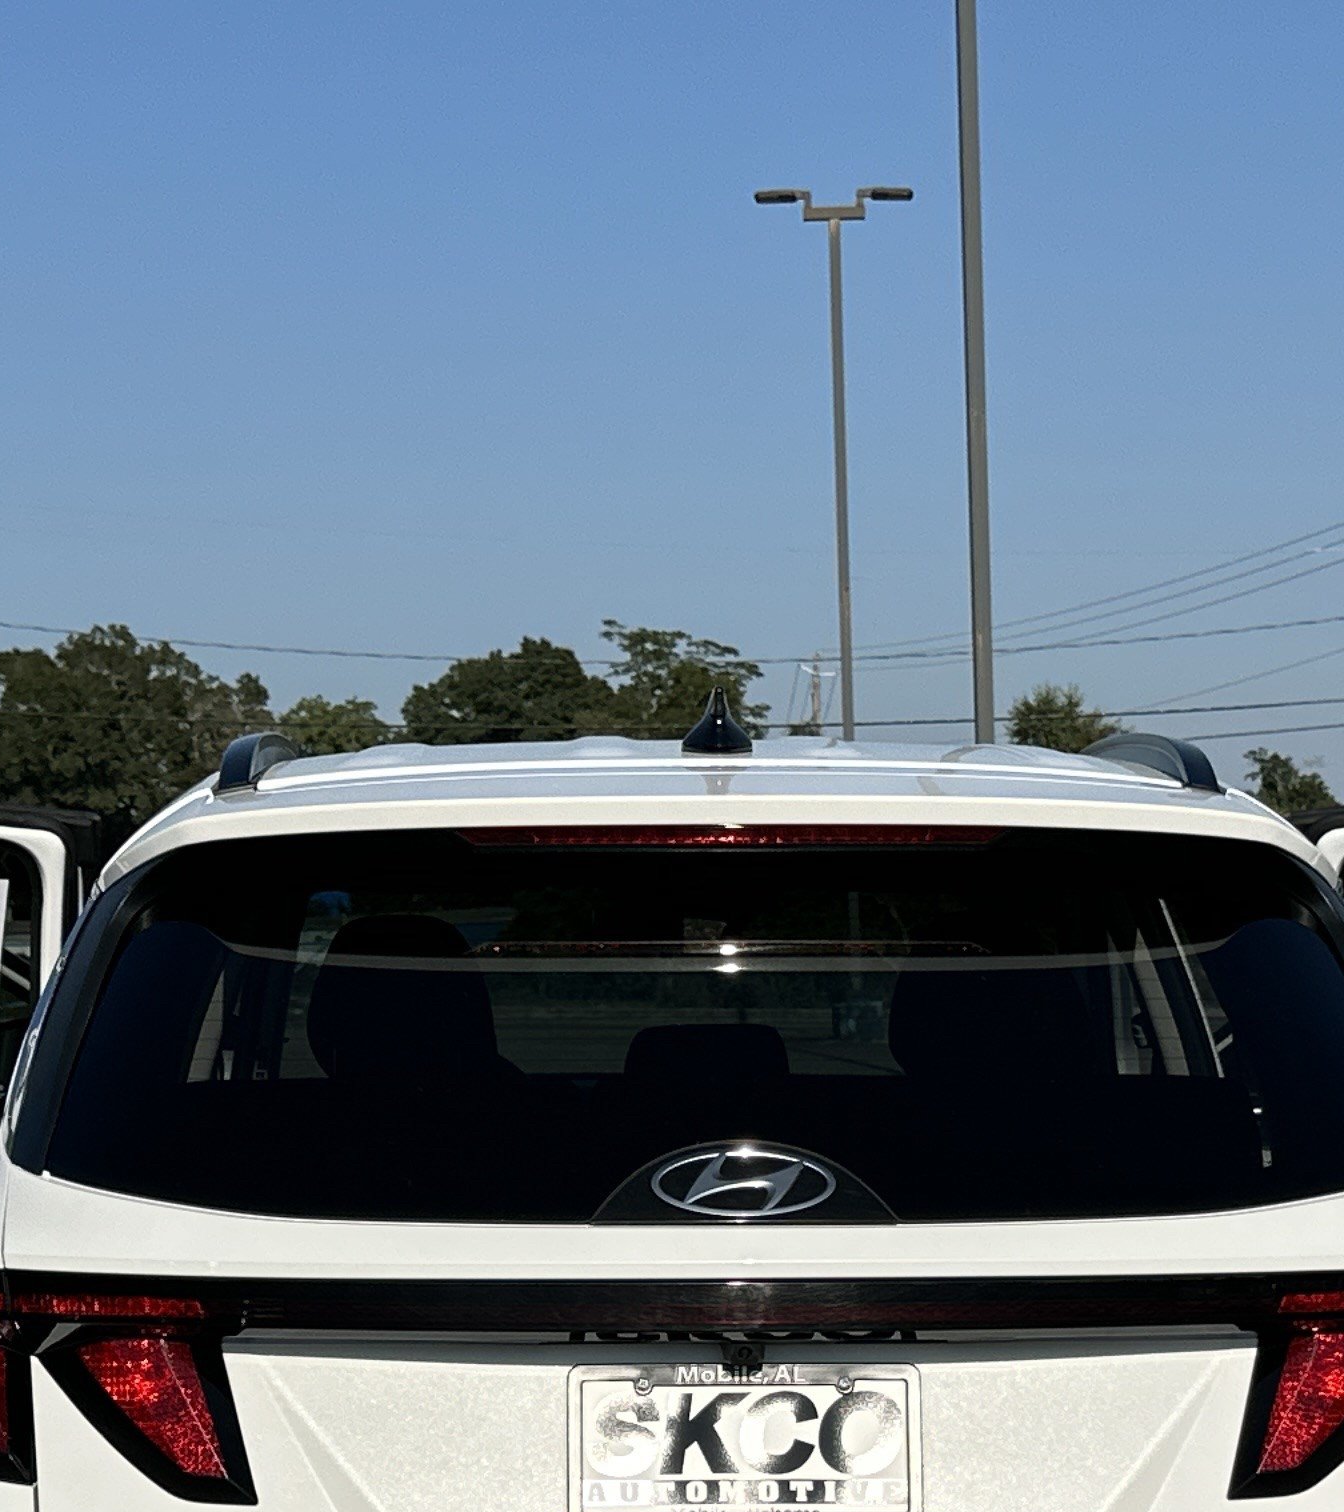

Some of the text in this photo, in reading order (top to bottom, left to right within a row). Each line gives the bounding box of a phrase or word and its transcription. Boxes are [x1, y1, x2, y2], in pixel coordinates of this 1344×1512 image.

[775, 1363, 809, 1384] AL
[586, 1391, 905, 1477] SKCO
[586, 1479, 908, 1505] AUTOMOTIVE
